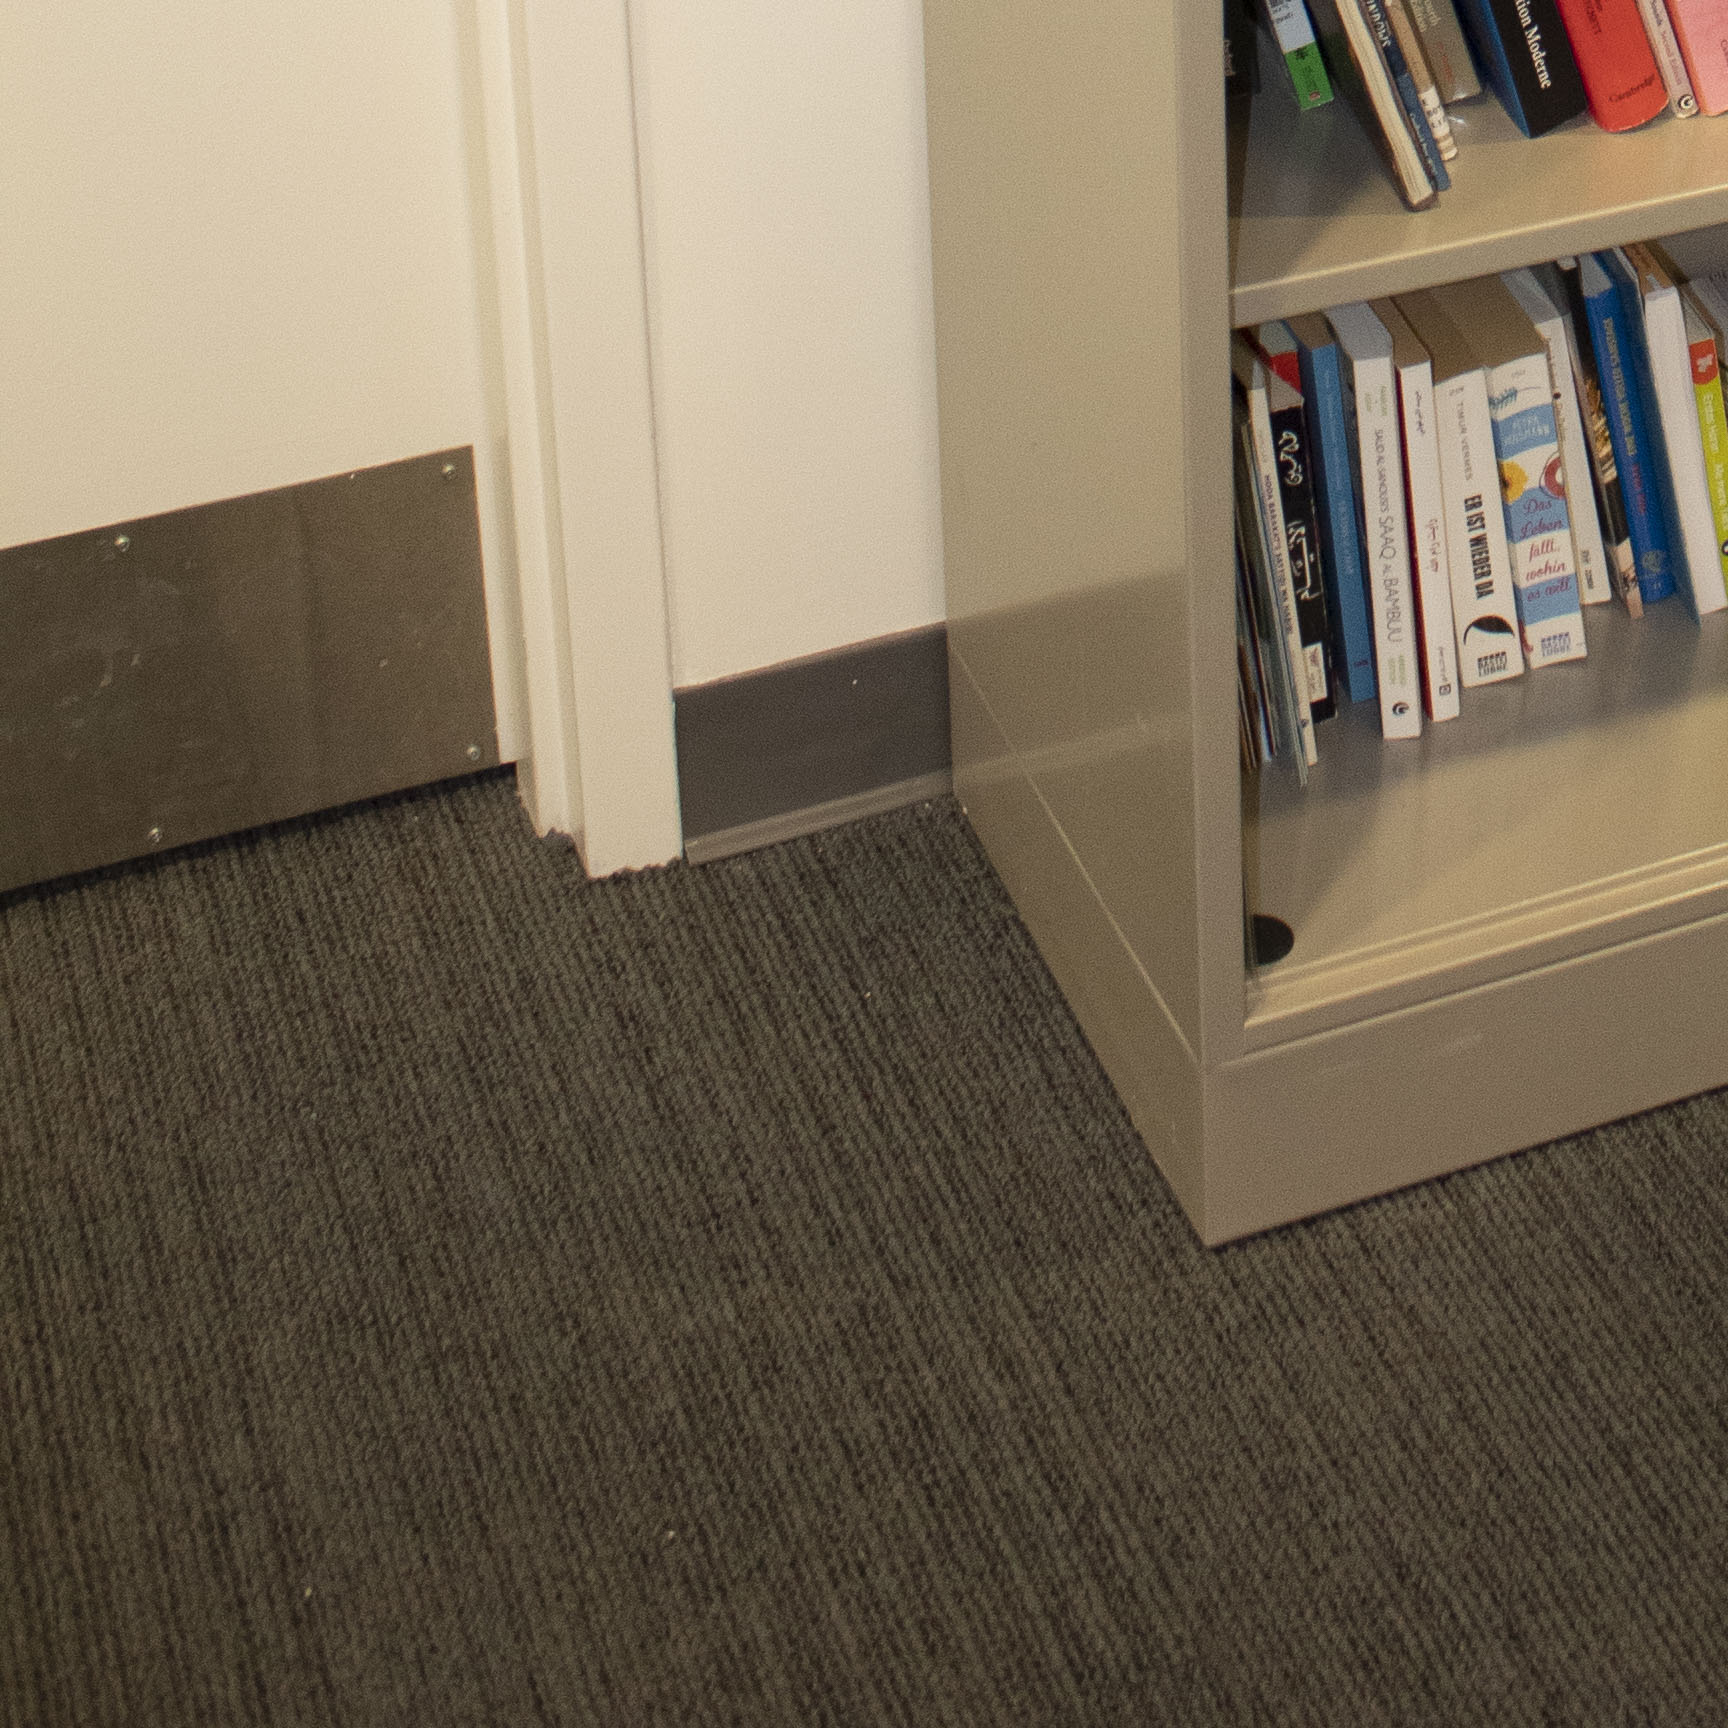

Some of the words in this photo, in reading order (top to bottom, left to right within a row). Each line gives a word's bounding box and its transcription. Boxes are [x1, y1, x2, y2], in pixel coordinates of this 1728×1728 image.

[1648, 0, 1665, 27] Sounds
[1520, 26, 1557, 90] Moderne
[1453, 401, 1469, 435] TIMUR
[1458, 438, 1475, 480] VERMES
[1463, 493, 1483, 511] ER
[1521, 493, 1553, 515] Das
[1464, 511, 1486, 532] IST
[1517, 513, 1564, 539] Leben
[1378, 515, 1397, 560] SAAQ
[1466, 532, 1494, 581] WIEDER
[1522, 556, 1567, 582] wohin
[1473, 579, 1494, 599] DA
